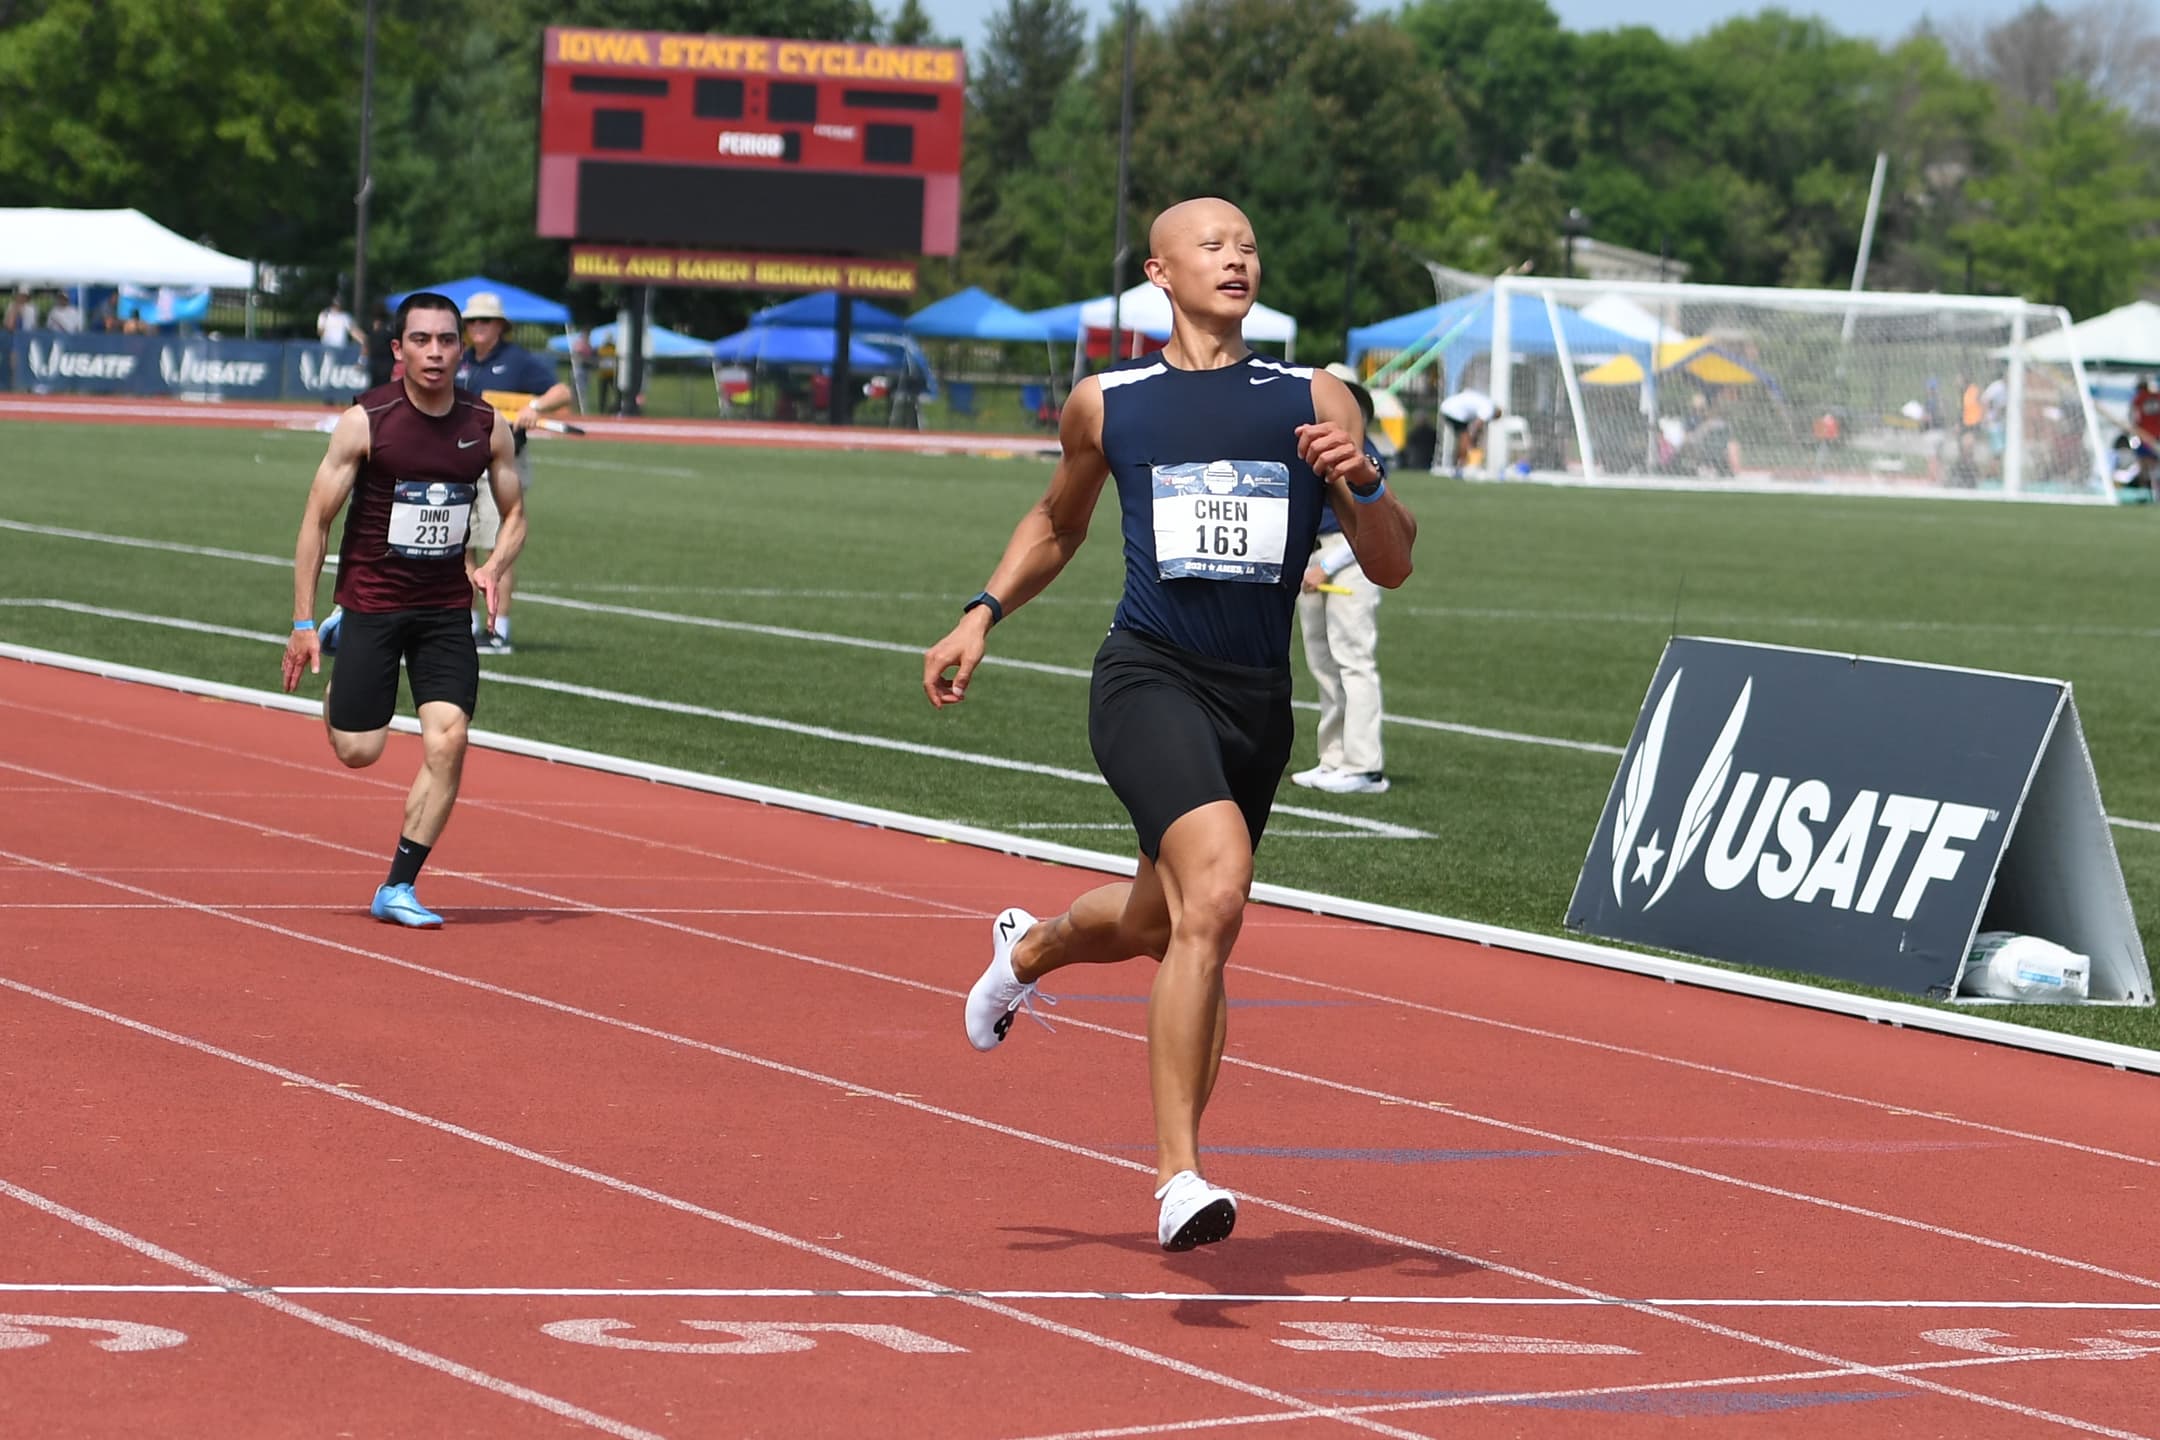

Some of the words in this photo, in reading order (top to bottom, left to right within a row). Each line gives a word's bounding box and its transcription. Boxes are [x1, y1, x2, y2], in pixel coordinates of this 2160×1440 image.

[557, 31, 650, 65] IOWA
[659, 37, 769, 72] STATE
[777, 42, 958, 82] CYCLONES
[718, 131, 785, 157] PERIOD
[573, 254, 619, 275] BILL
[625, 257, 673, 278] AND
[676, 260, 748, 281] KAREN
[845, 265, 914, 290] TRACK
[59, 354, 137, 379] USATF
[189, 361, 269, 385] USATF
[420, 510, 450, 522] DINO
[1195, 500, 1248, 522] CHEN
[415, 526, 450, 544] 233
[1196, 525, 1248, 557] 163
[1704, 772, 1990, 920] USATF
